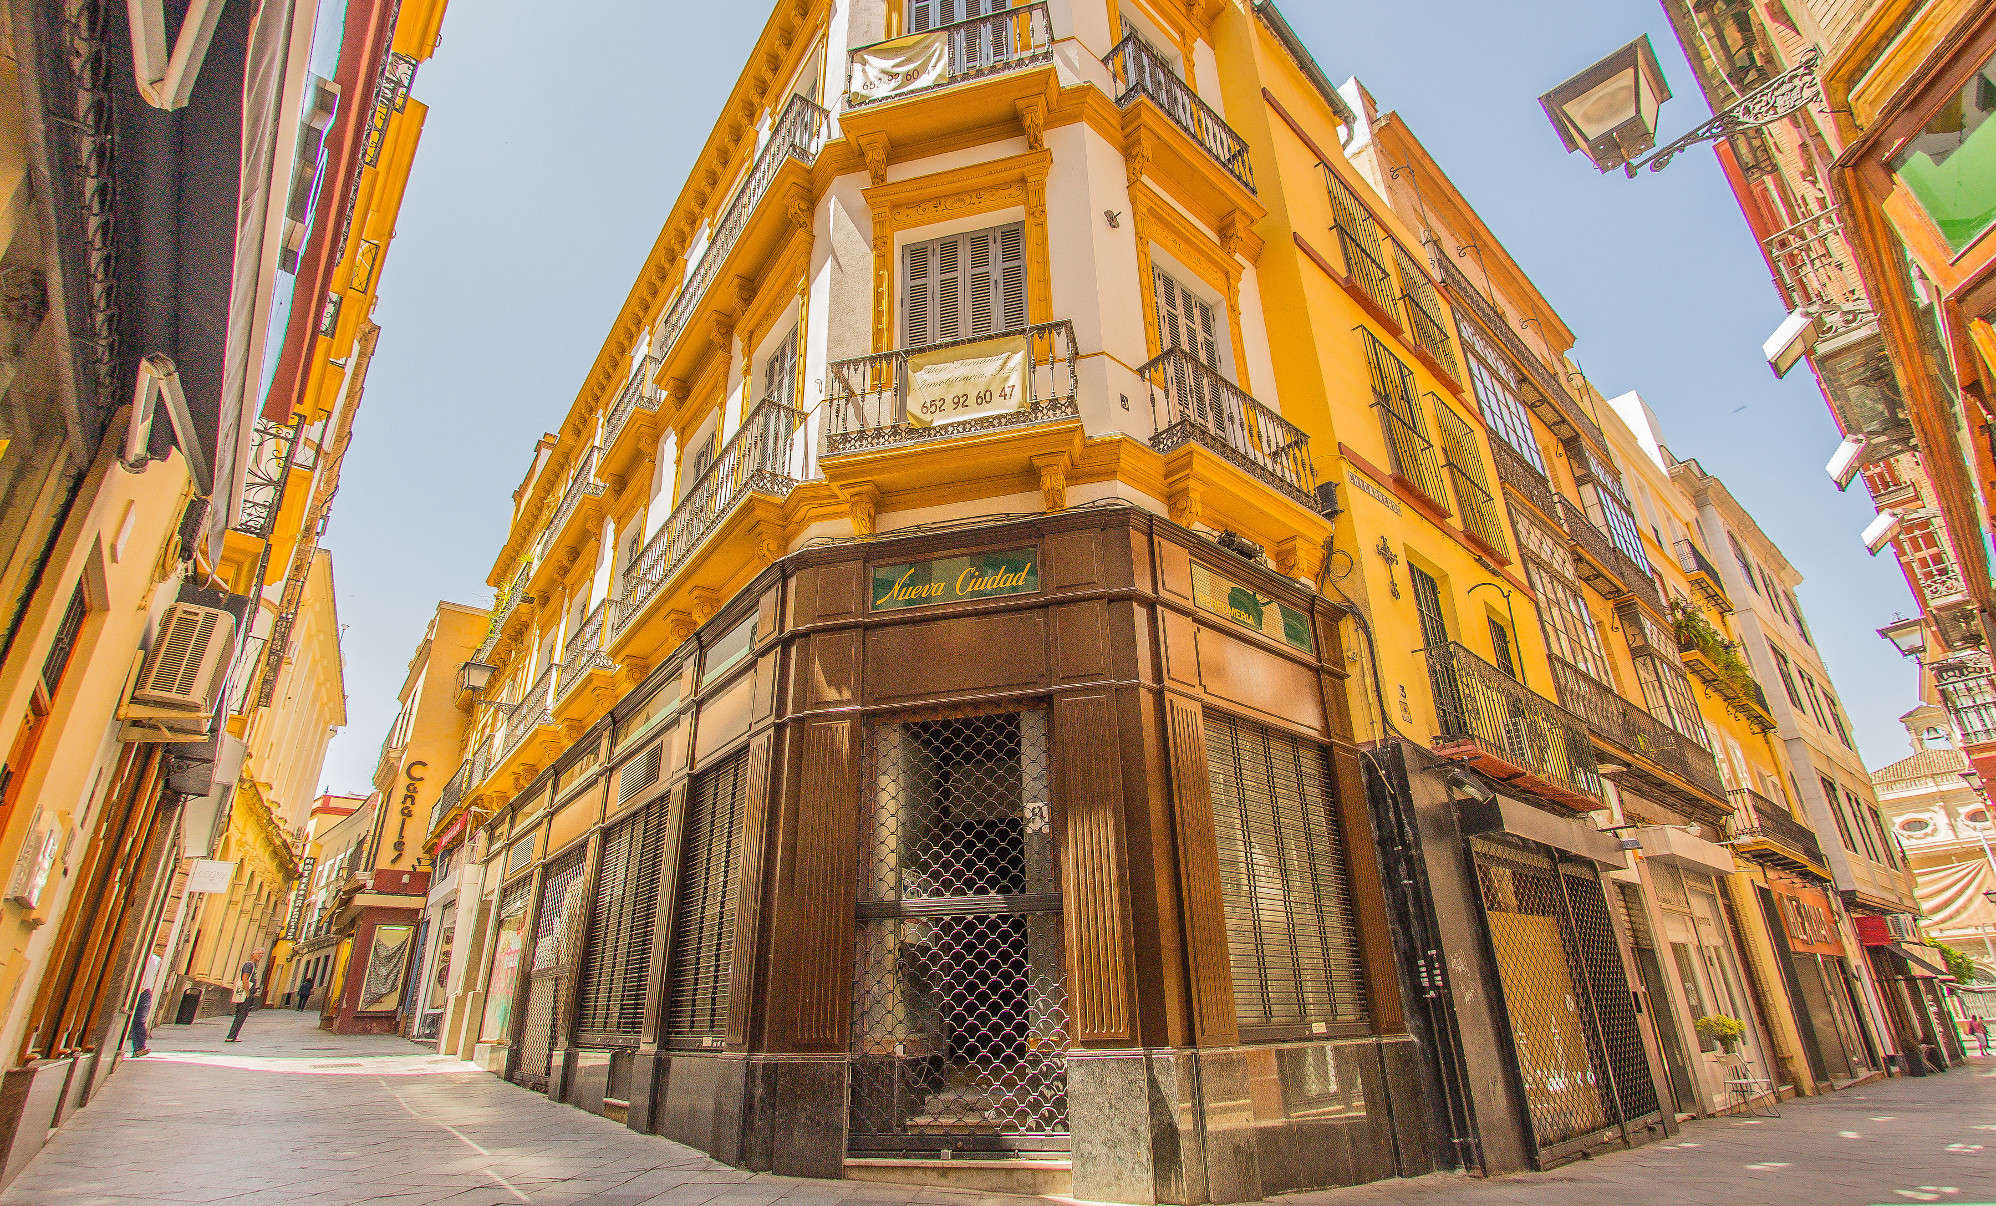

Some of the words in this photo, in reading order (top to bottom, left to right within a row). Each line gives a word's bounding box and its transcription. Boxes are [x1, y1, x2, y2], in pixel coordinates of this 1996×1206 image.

[905, 69, 920, 81] 60
[921, 397, 946, 415] 652
[952, 393, 969, 411] 92
[975, 389, 993, 406] 60
[998, 384, 1016, 401] 47
[875, 567, 946, 606] Nueva
[955, 562, 1032, 596] Ciudad
